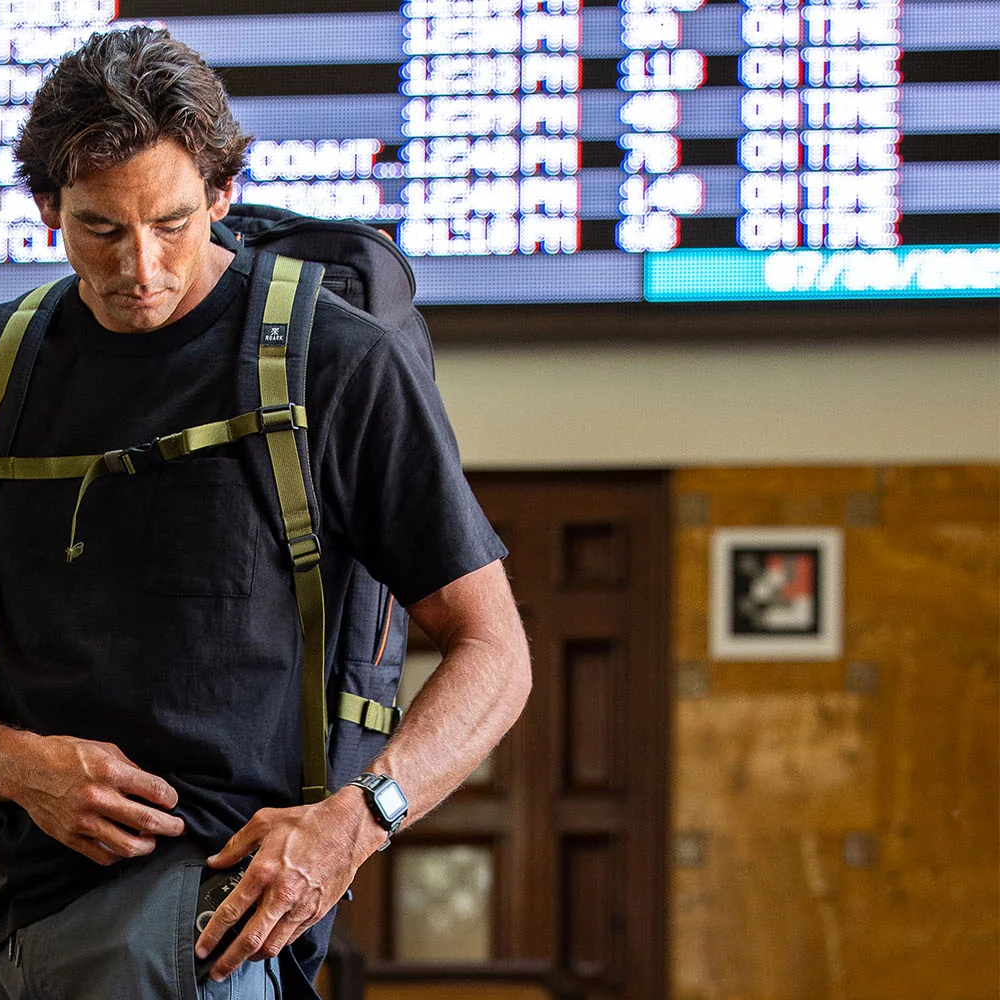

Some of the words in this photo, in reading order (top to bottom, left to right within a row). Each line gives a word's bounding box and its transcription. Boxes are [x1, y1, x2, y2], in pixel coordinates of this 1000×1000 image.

[740, 6, 801, 45] ON
[802, 3, 903, 44] TIME
[739, 46, 801, 86] ON
[802, 44, 903, 85] TIME
[739, 89, 800, 129] ON
[801, 87, 903, 127] TIME
[738, 130, 801, 170] ON
[802, 128, 903, 168] TIME
[739, 172, 800, 211] ON
[801, 170, 903, 210] TIME
[737, 210, 801, 249] ON
[802, 208, 902, 248] TIME
